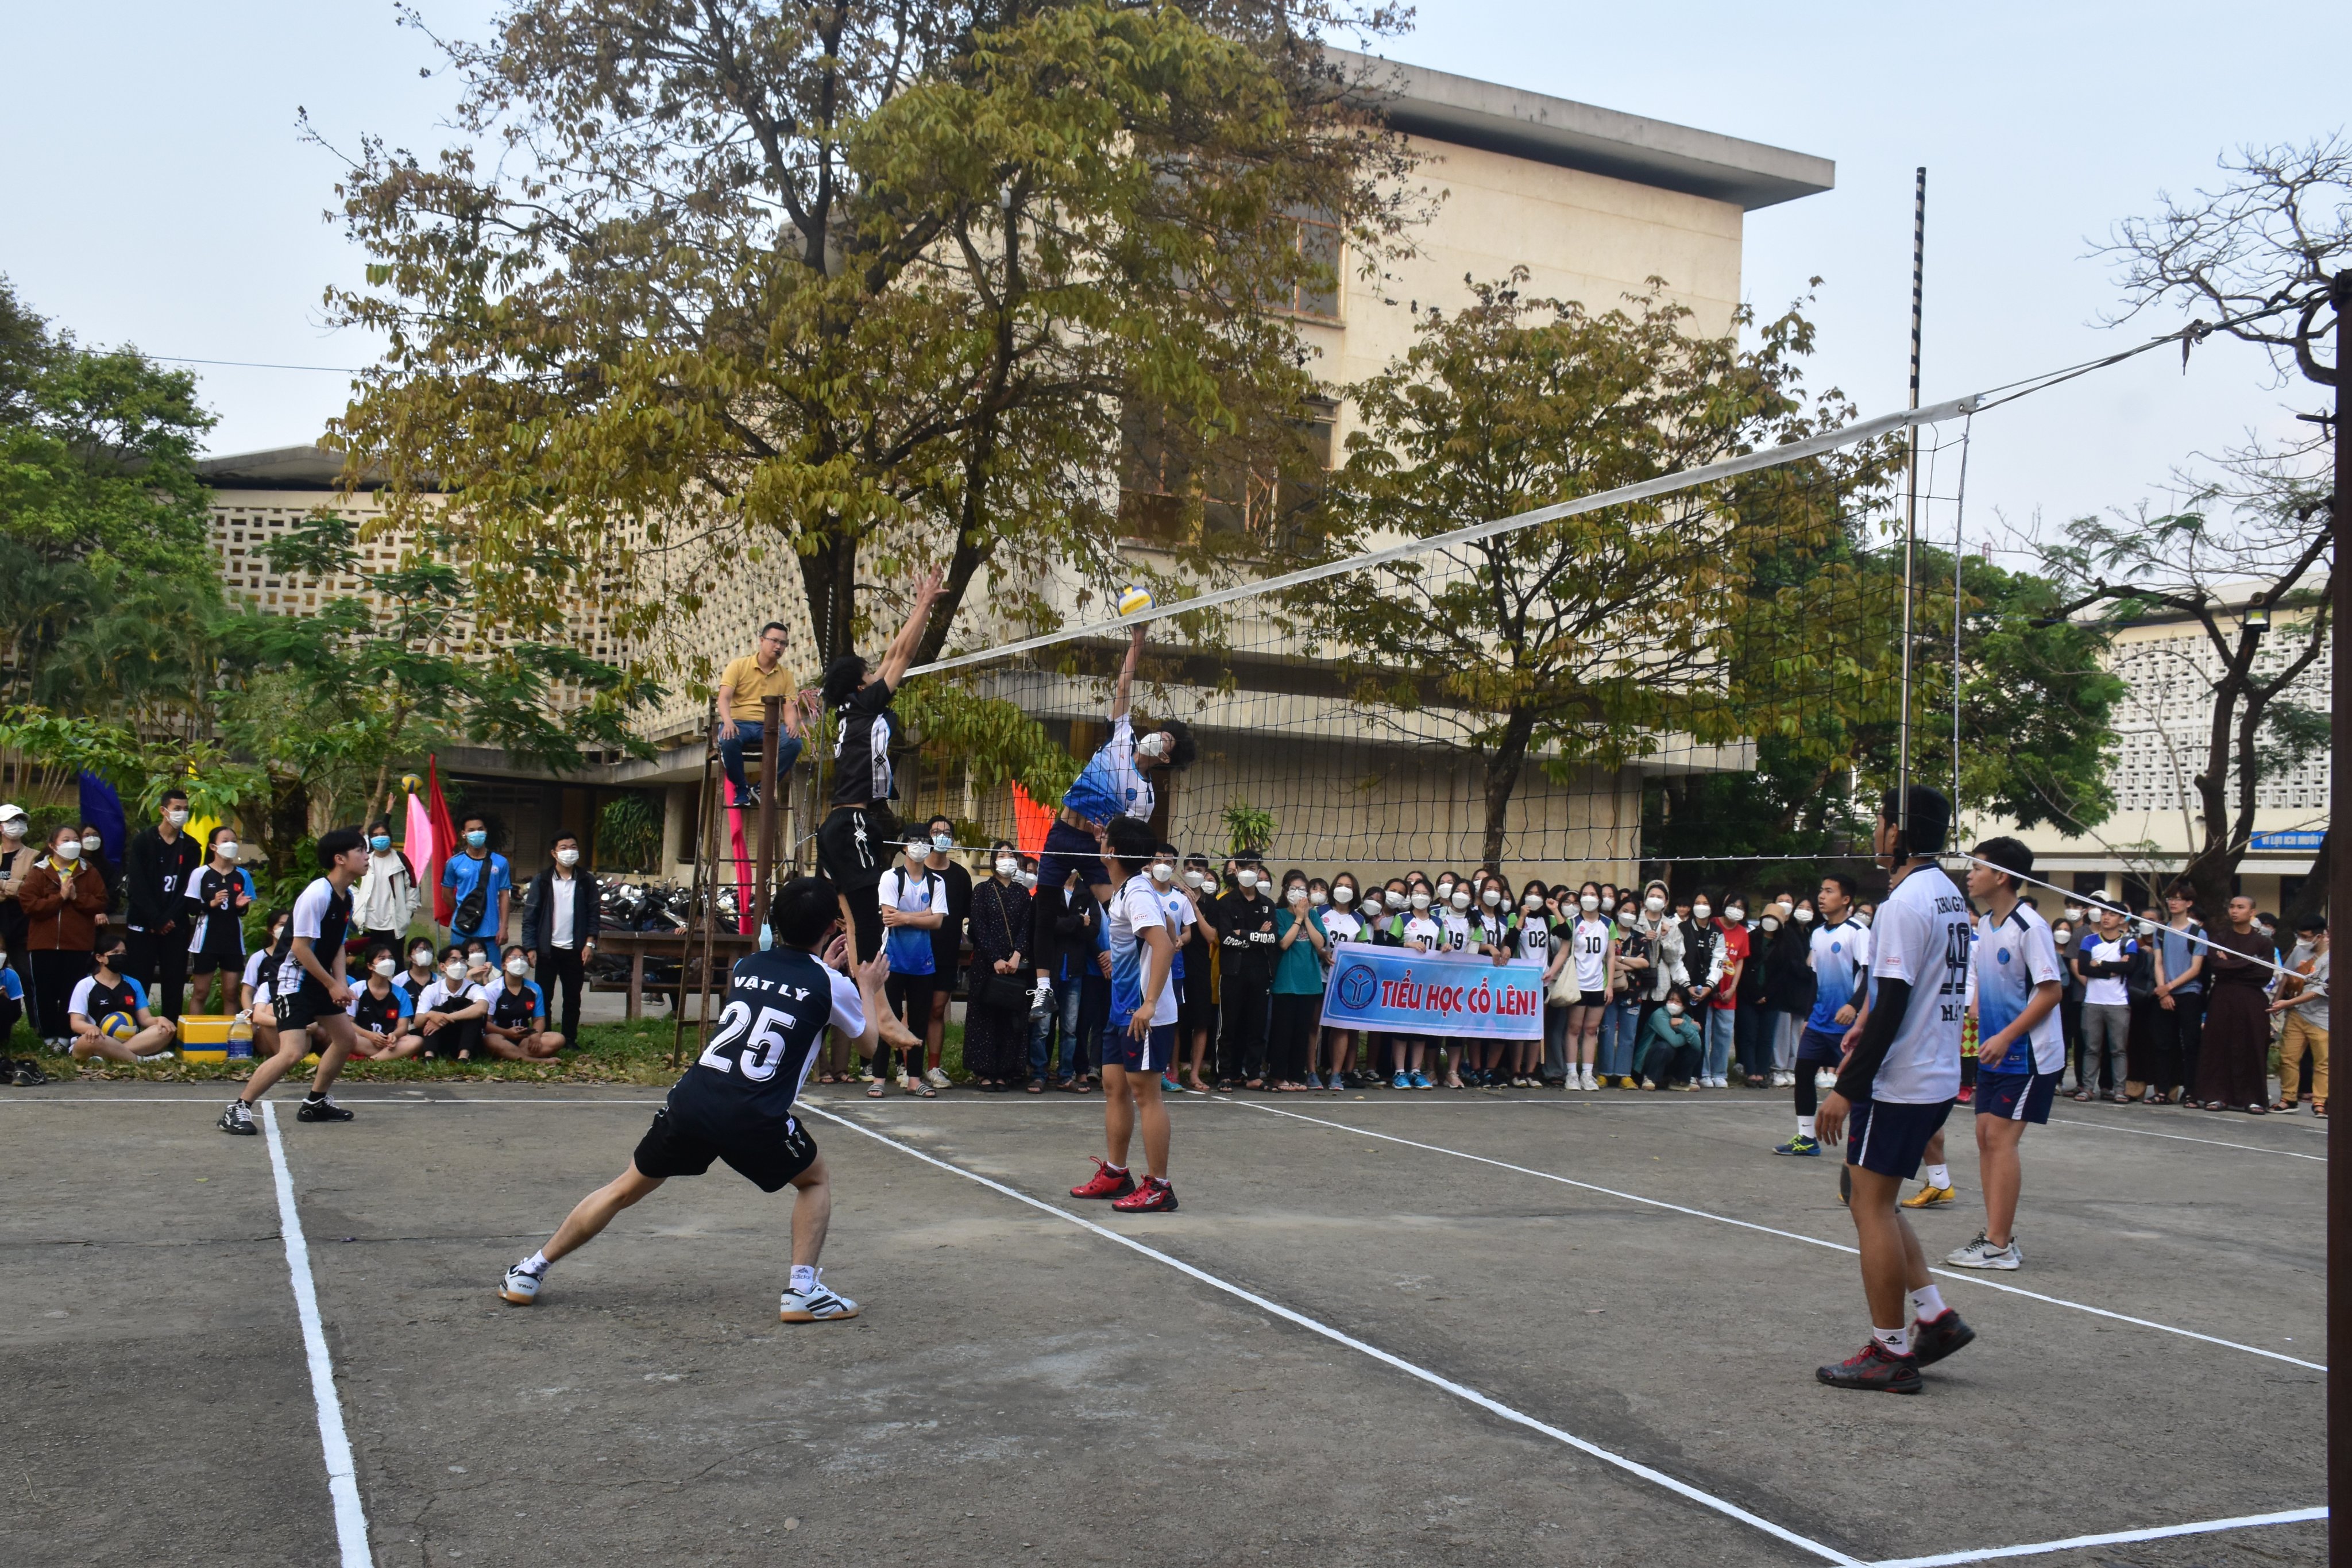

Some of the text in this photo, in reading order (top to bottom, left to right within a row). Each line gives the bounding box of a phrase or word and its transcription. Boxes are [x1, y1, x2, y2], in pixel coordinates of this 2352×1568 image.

[164, 875, 178, 892] 27
[221, 898, 229, 910] 3
[1448, 930, 1463, 951] 19
[1529, 930, 1546, 948] 02
[1585, 936, 1601, 953] 10
[734, 975, 811, 1001] VẬT LÝ
[1381, 969, 1423, 1011] TIỂU
[1426, 984, 1463, 1018] HỌC
[1467, 976, 1491, 1014] CỐ
[1496, 984, 1537, 1017] LÊN!
[699, 1001, 797, 1082] 25
